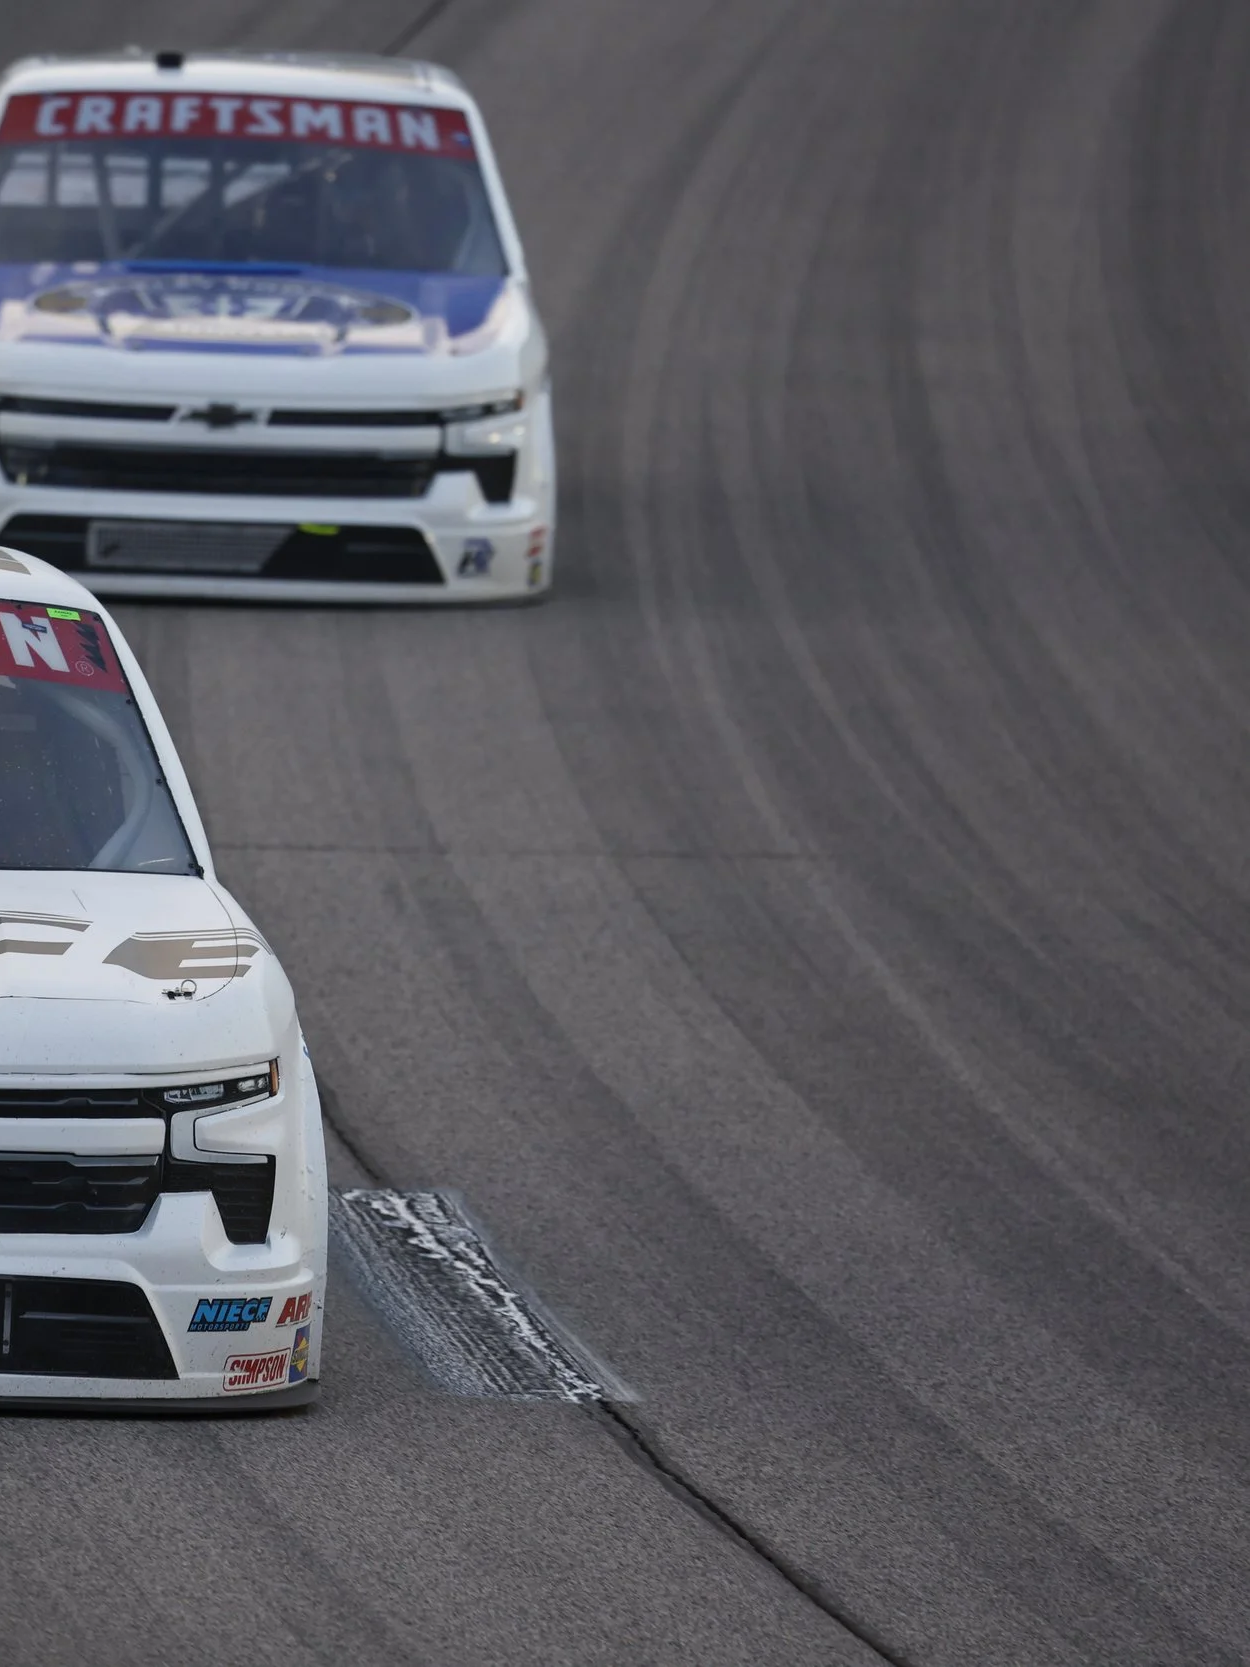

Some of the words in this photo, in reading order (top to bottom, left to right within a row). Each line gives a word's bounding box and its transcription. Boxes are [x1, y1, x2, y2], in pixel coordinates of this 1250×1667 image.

[35, 95, 441, 151] CRAFTSMAN
[189, 1322, 251, 1332] MOTORSPORTS
[228, 1353, 288, 1386] SIMPSON
